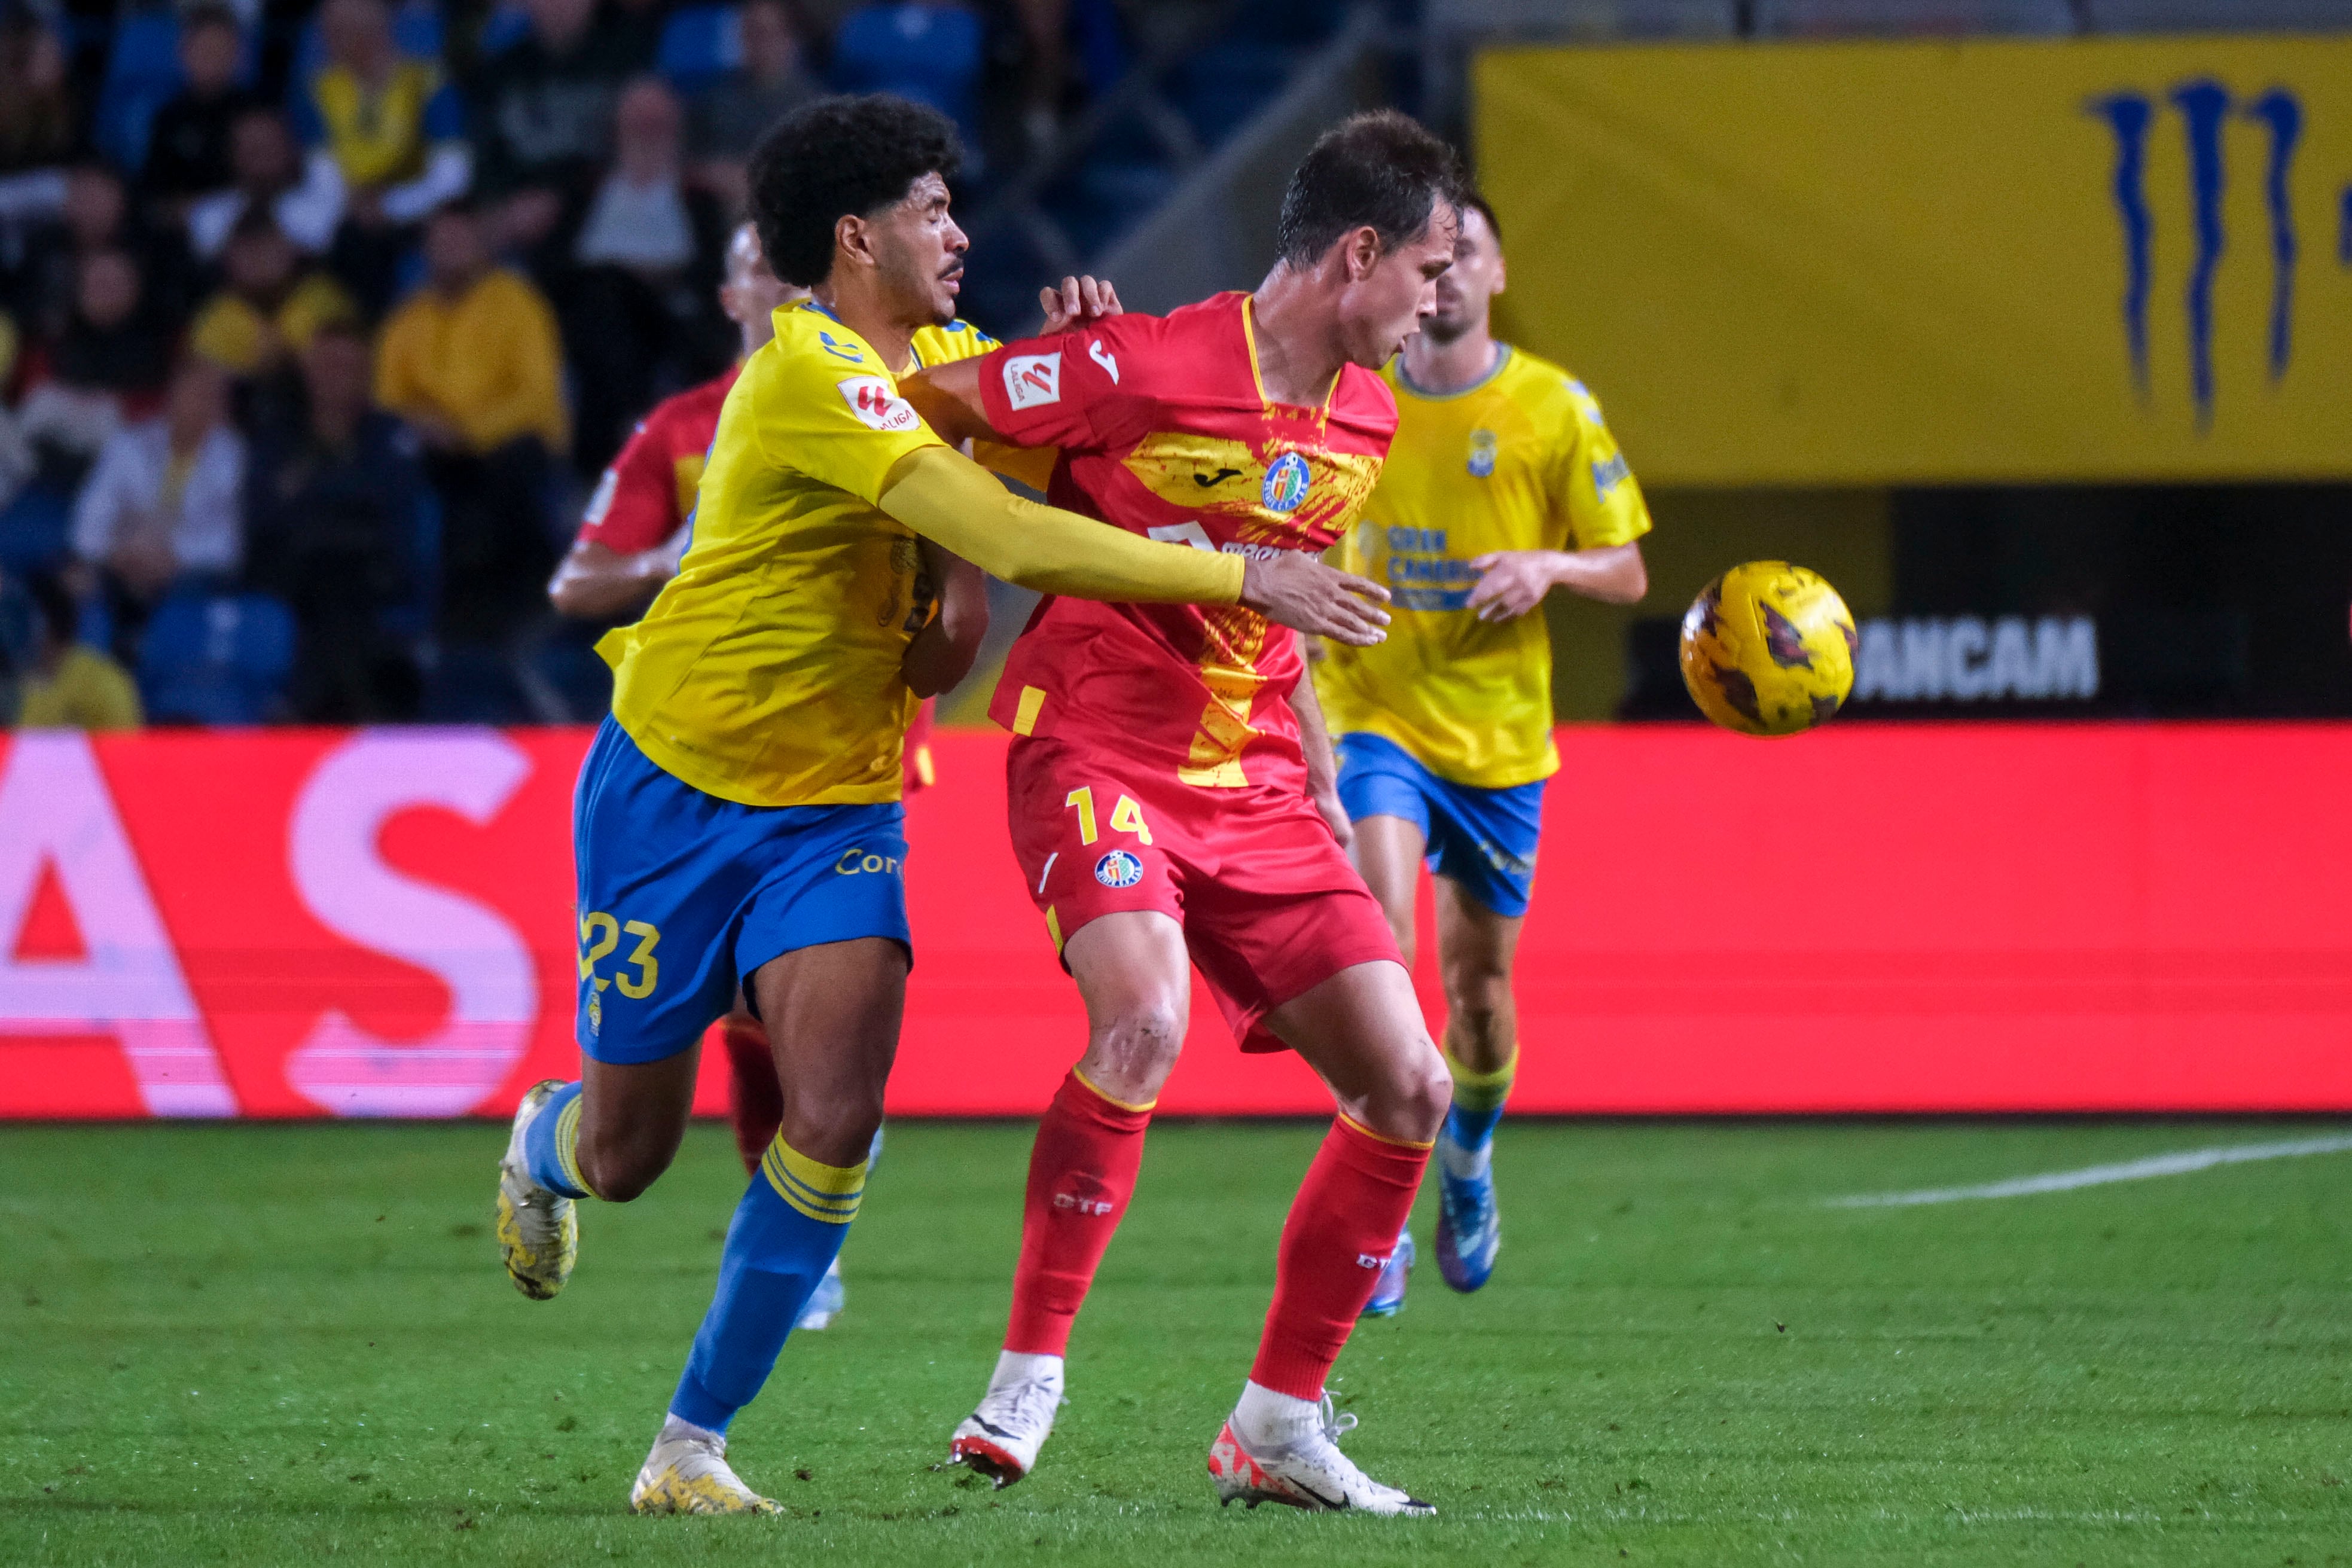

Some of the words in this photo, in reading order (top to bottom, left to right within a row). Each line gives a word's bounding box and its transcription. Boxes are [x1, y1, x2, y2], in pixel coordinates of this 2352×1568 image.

[880, 409, 913, 430] ALIGA
[1855, 616, 2098, 702] ANCAM
[1066, 785, 1153, 846] 14
[578, 911, 661, 999] 23
